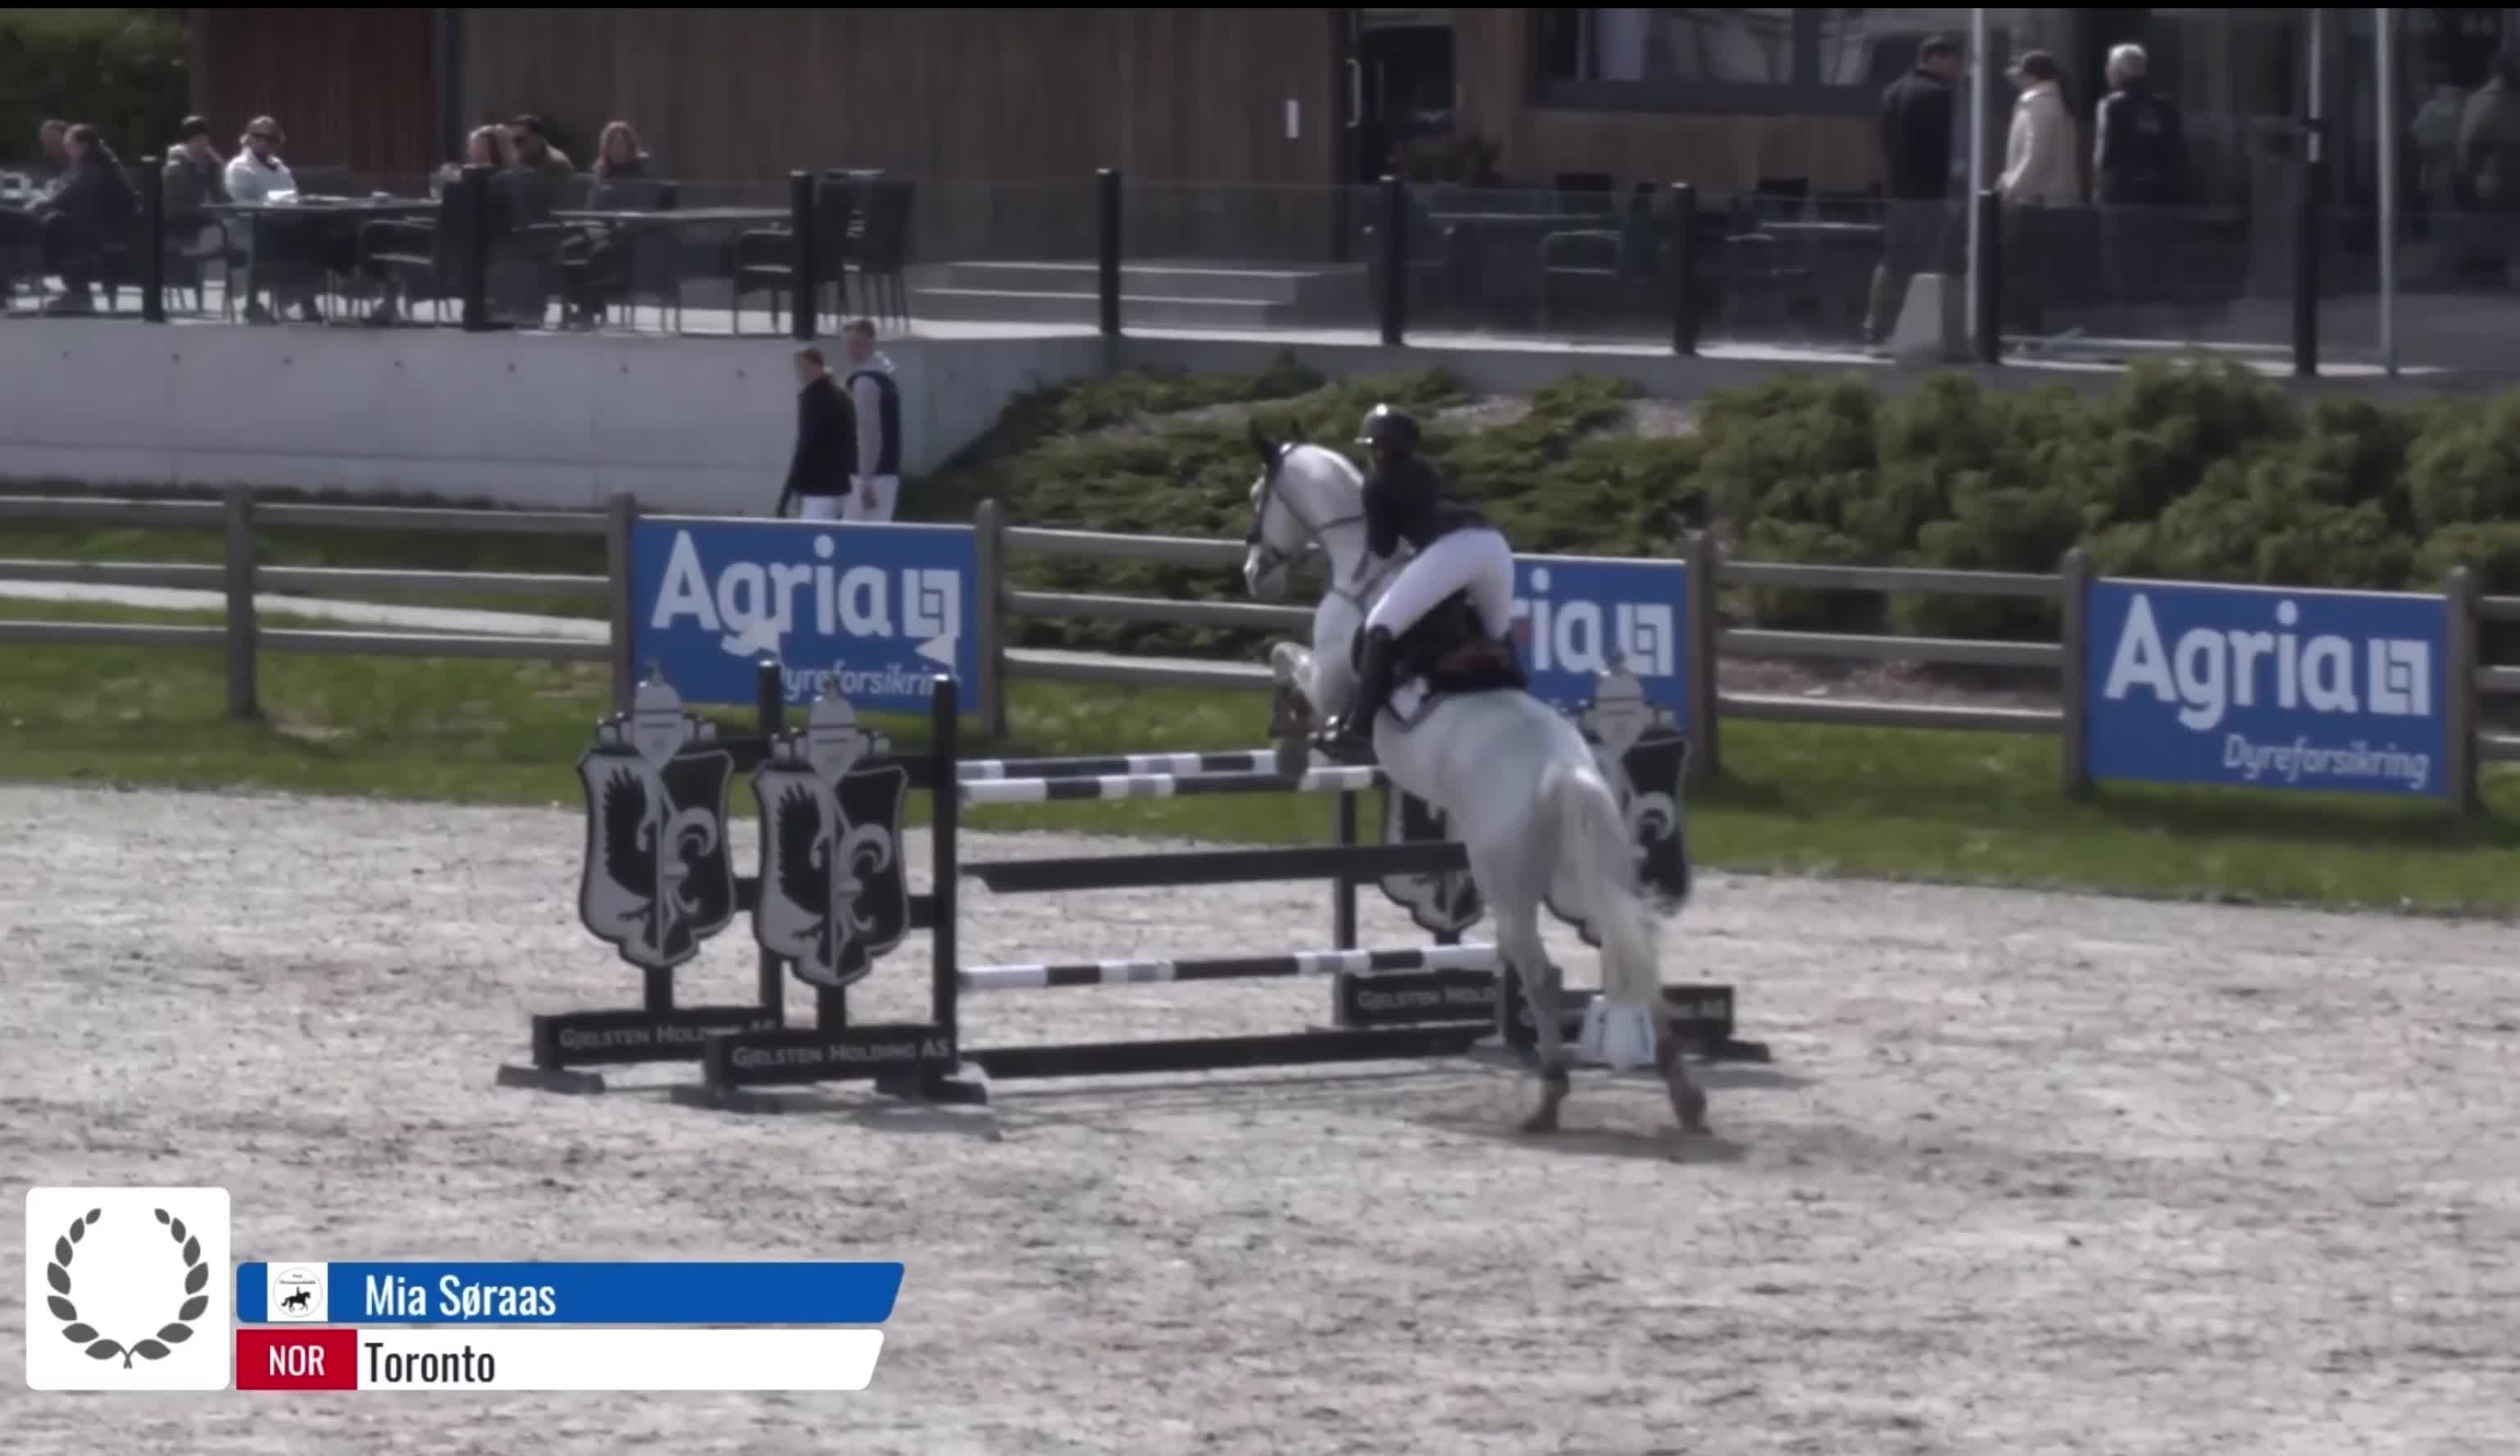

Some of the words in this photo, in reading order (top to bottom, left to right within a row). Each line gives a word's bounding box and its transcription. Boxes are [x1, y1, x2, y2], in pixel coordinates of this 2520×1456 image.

[652, 529, 893, 657] Agria
[2104, 593, 2359, 730] Agria
[2223, 733, 2431, 790] Dyreforsikring
[921, 1038, 950, 1058] AS
